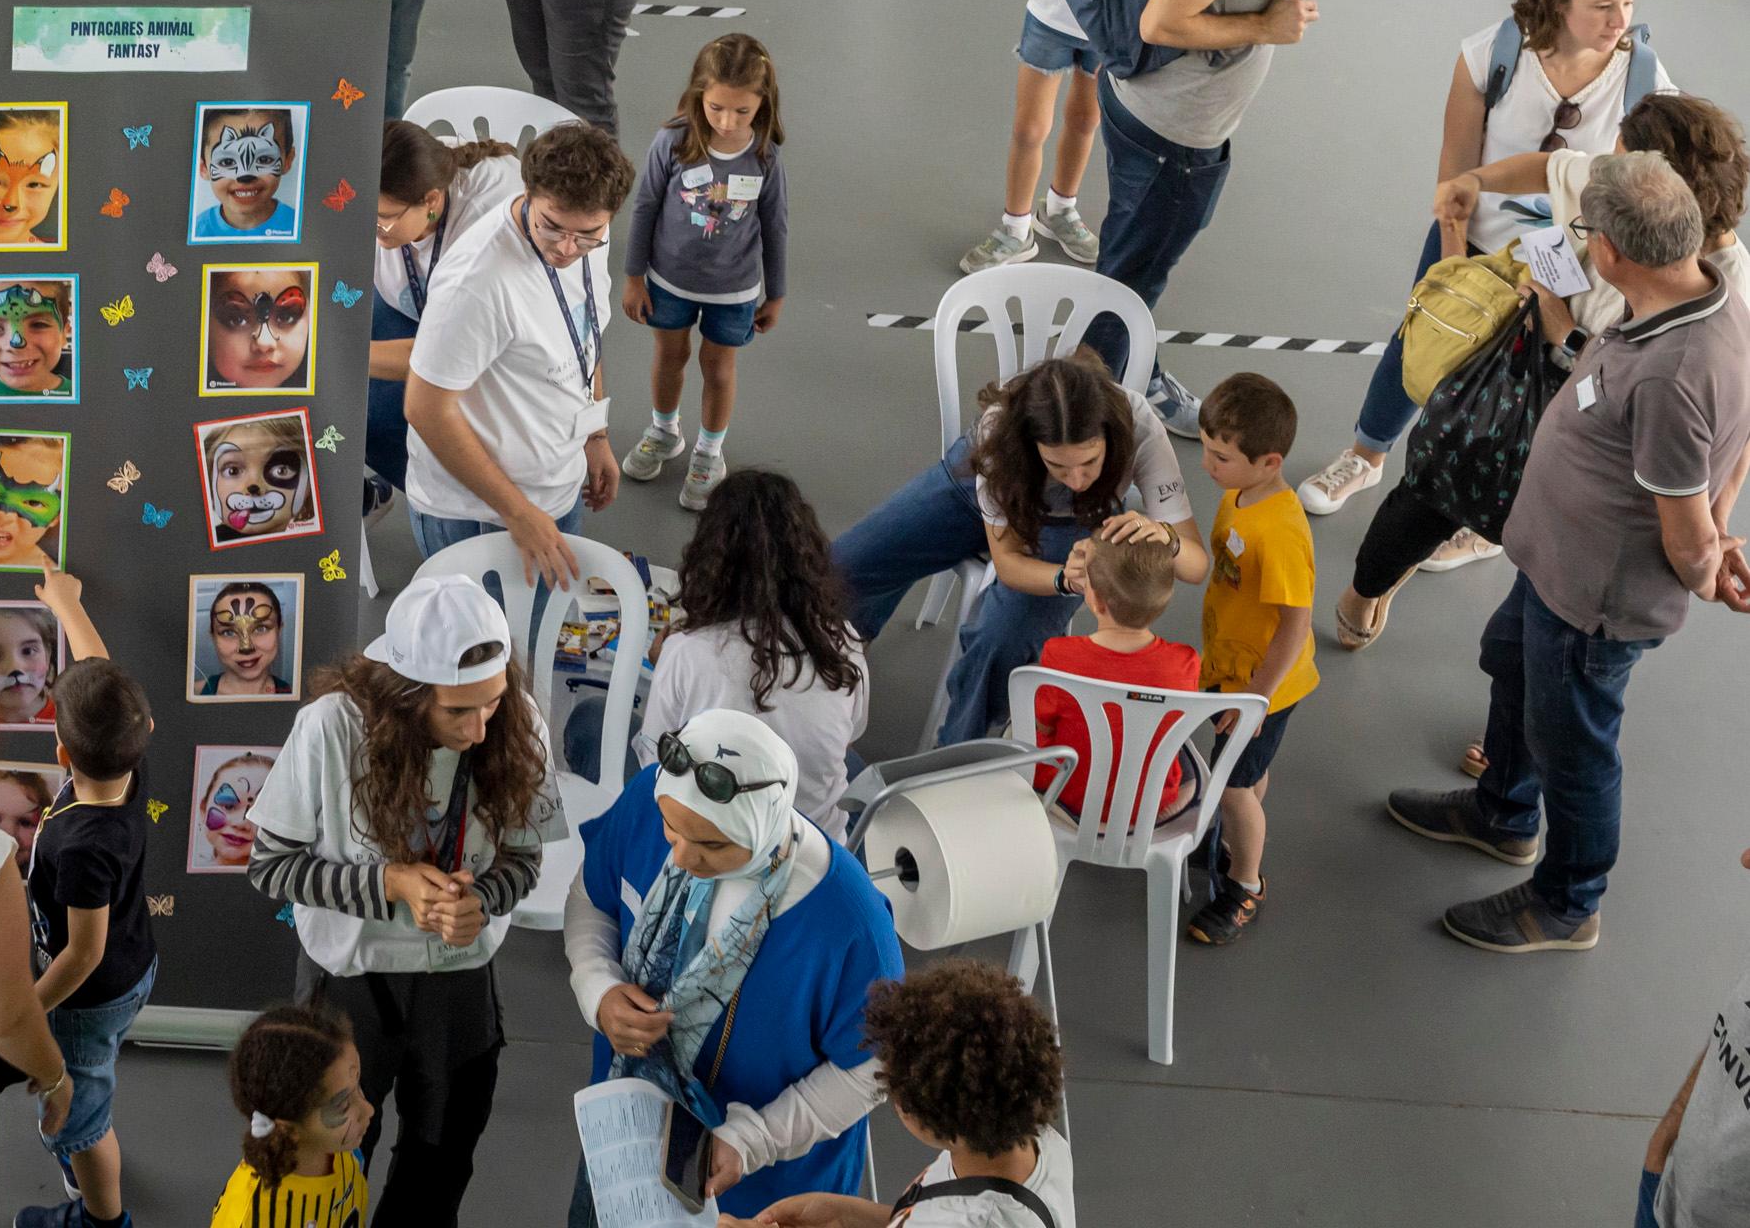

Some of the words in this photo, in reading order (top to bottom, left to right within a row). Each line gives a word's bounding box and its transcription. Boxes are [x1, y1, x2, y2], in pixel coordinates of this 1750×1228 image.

[70, 21, 143, 37] PINTACARES
[147, 21, 195, 37] ANIMAL
[107, 43, 160, 59] FANTASY
